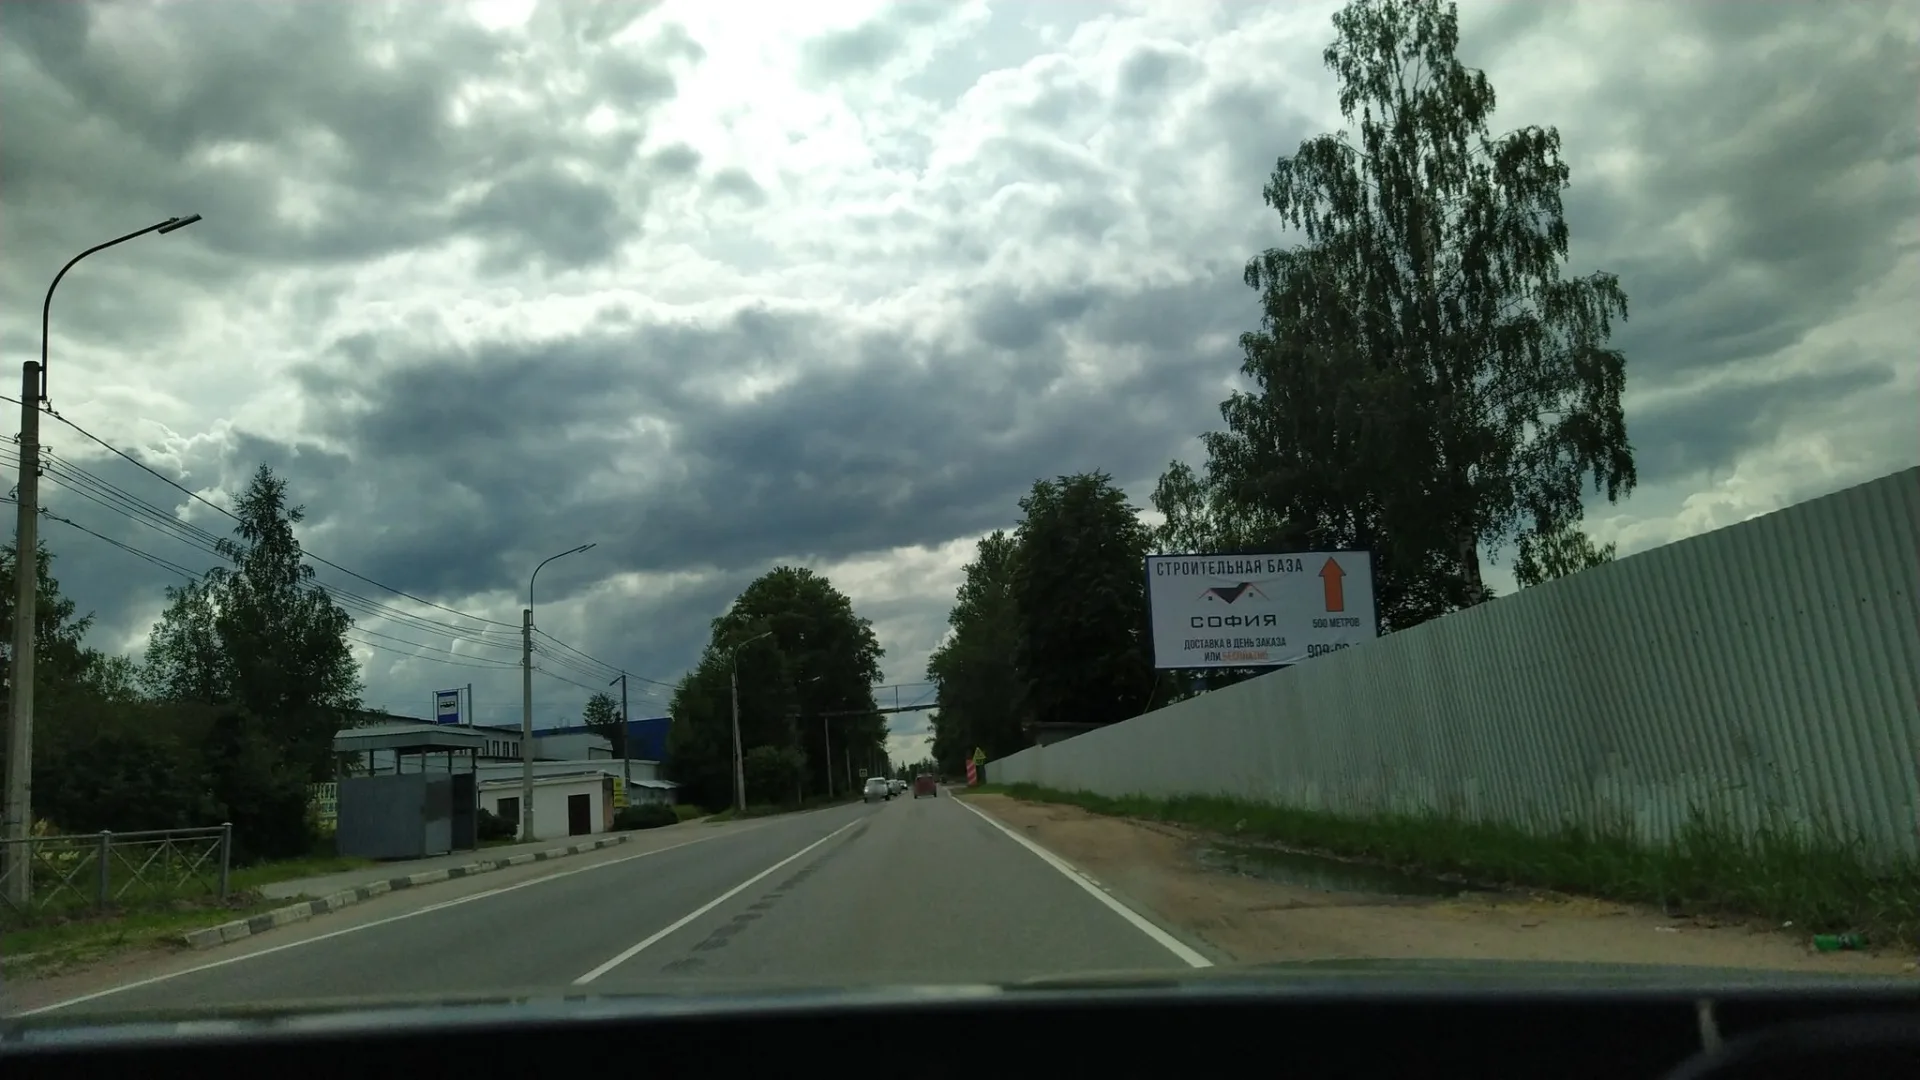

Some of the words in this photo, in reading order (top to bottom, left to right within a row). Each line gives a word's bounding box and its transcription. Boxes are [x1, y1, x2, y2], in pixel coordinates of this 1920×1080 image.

[1156, 560, 1262, 576] СТРОИТЕЛЬНАЯ
[1267, 558, 1304, 573] БАЗА
[1190, 614, 1277, 629] СОФИЯ
[1312, 618, 1328, 628] 500
[1329, 617, 1360, 628] МЕТРОВ
[1184, 638, 1224, 650] ДОСТАВКА
[1226, 638, 1232, 647] В
[1233, 637, 1254, 649] ДЕНЬ
[1256, 636, 1287, 647] ЗАКАЗА
[1204, 651, 1221, 662] ИЛИ
